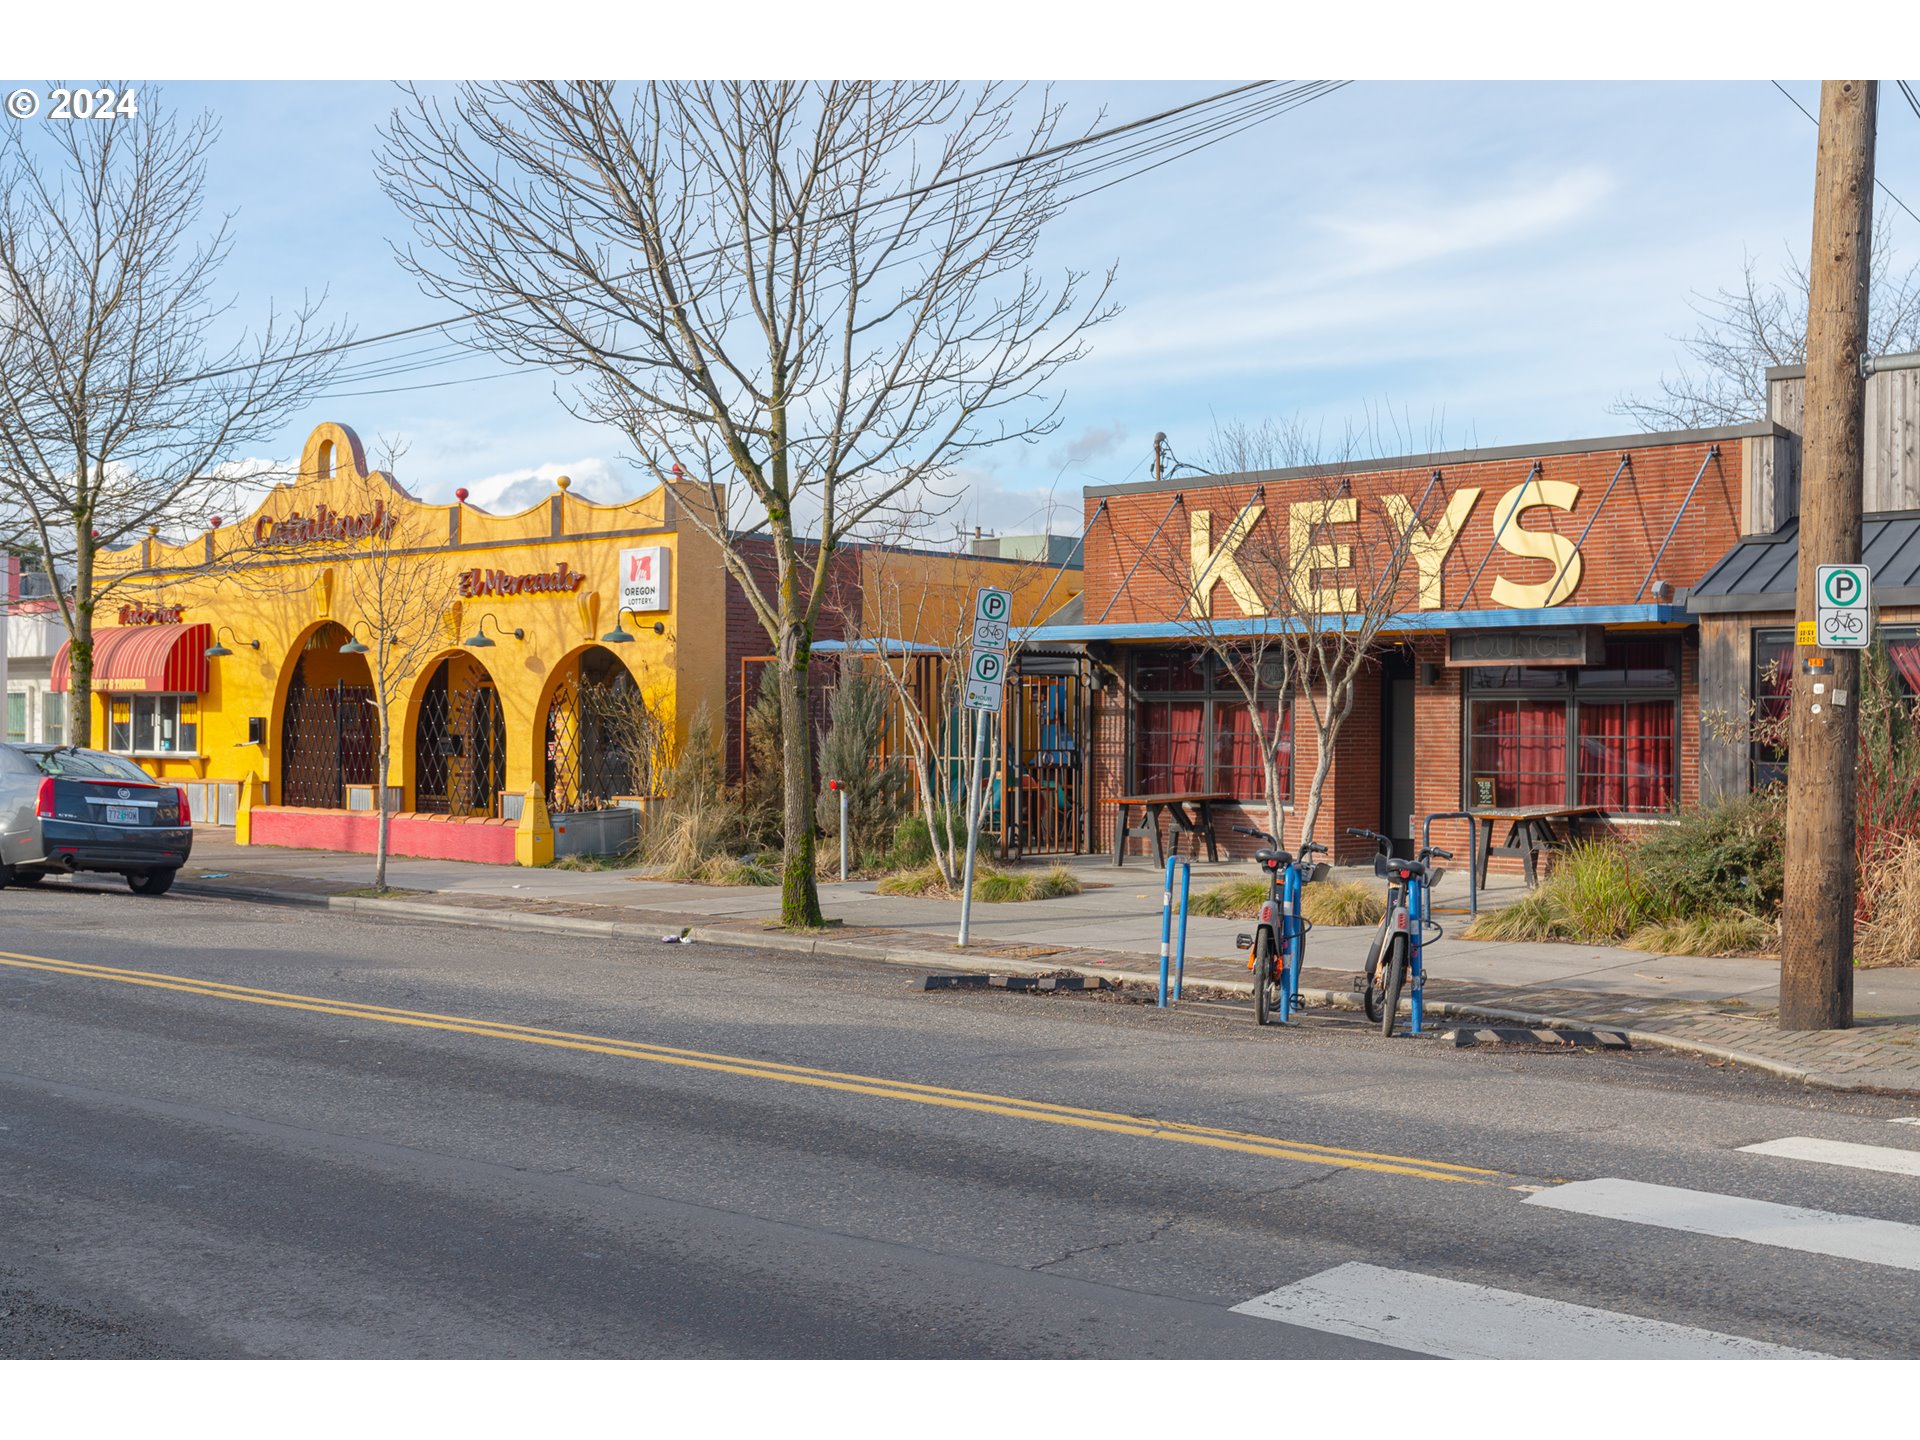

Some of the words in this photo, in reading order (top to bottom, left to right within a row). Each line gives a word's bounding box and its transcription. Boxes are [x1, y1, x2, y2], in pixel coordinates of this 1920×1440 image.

[1190, 480, 1581, 618] KEYS
[459, 568, 484, 598] El
[484, 562, 586, 597] Mercado
[1836, 577, 1853, 599] P
[625, 587, 655, 596] OREGON
[989, 598, 1001, 614] P
[1461, 635, 1569, 658] LOUNGE
[983, 659, 995, 675] P
[983, 686, 988, 695] 1
